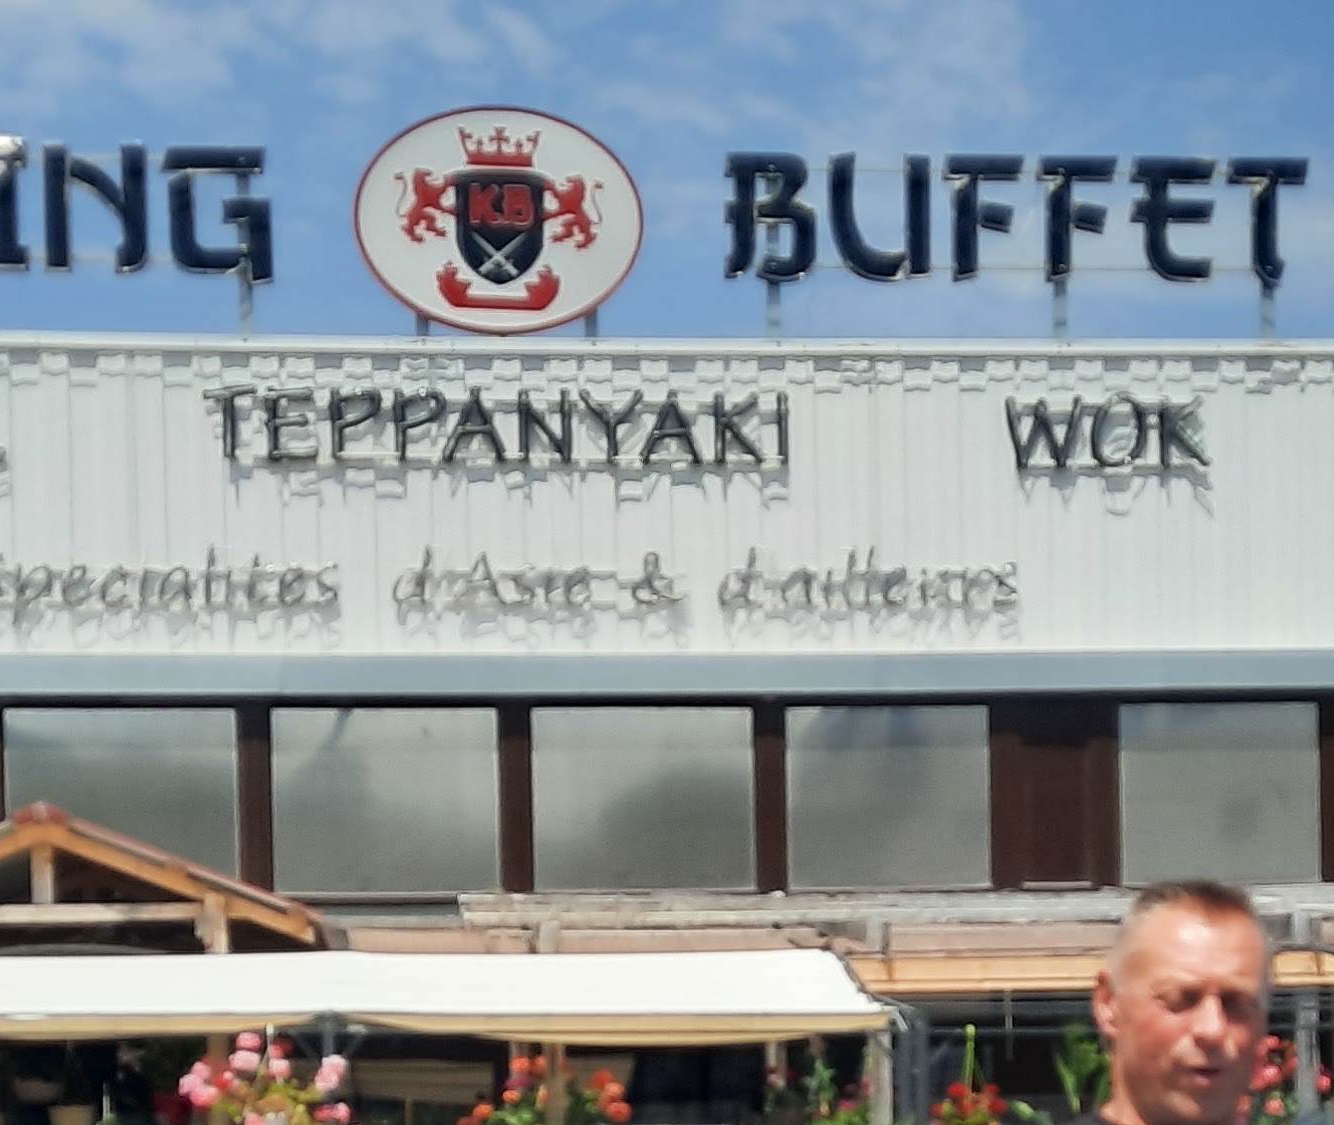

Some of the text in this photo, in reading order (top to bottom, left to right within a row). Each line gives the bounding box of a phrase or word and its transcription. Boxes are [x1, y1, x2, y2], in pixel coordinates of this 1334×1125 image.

[468, 182, 534, 226] KB
[723, 150, 1309, 283] BUFFET
[202, 385, 790, 463] TEPPANYAKI
[1005, 391, 1212, 468] WOK
